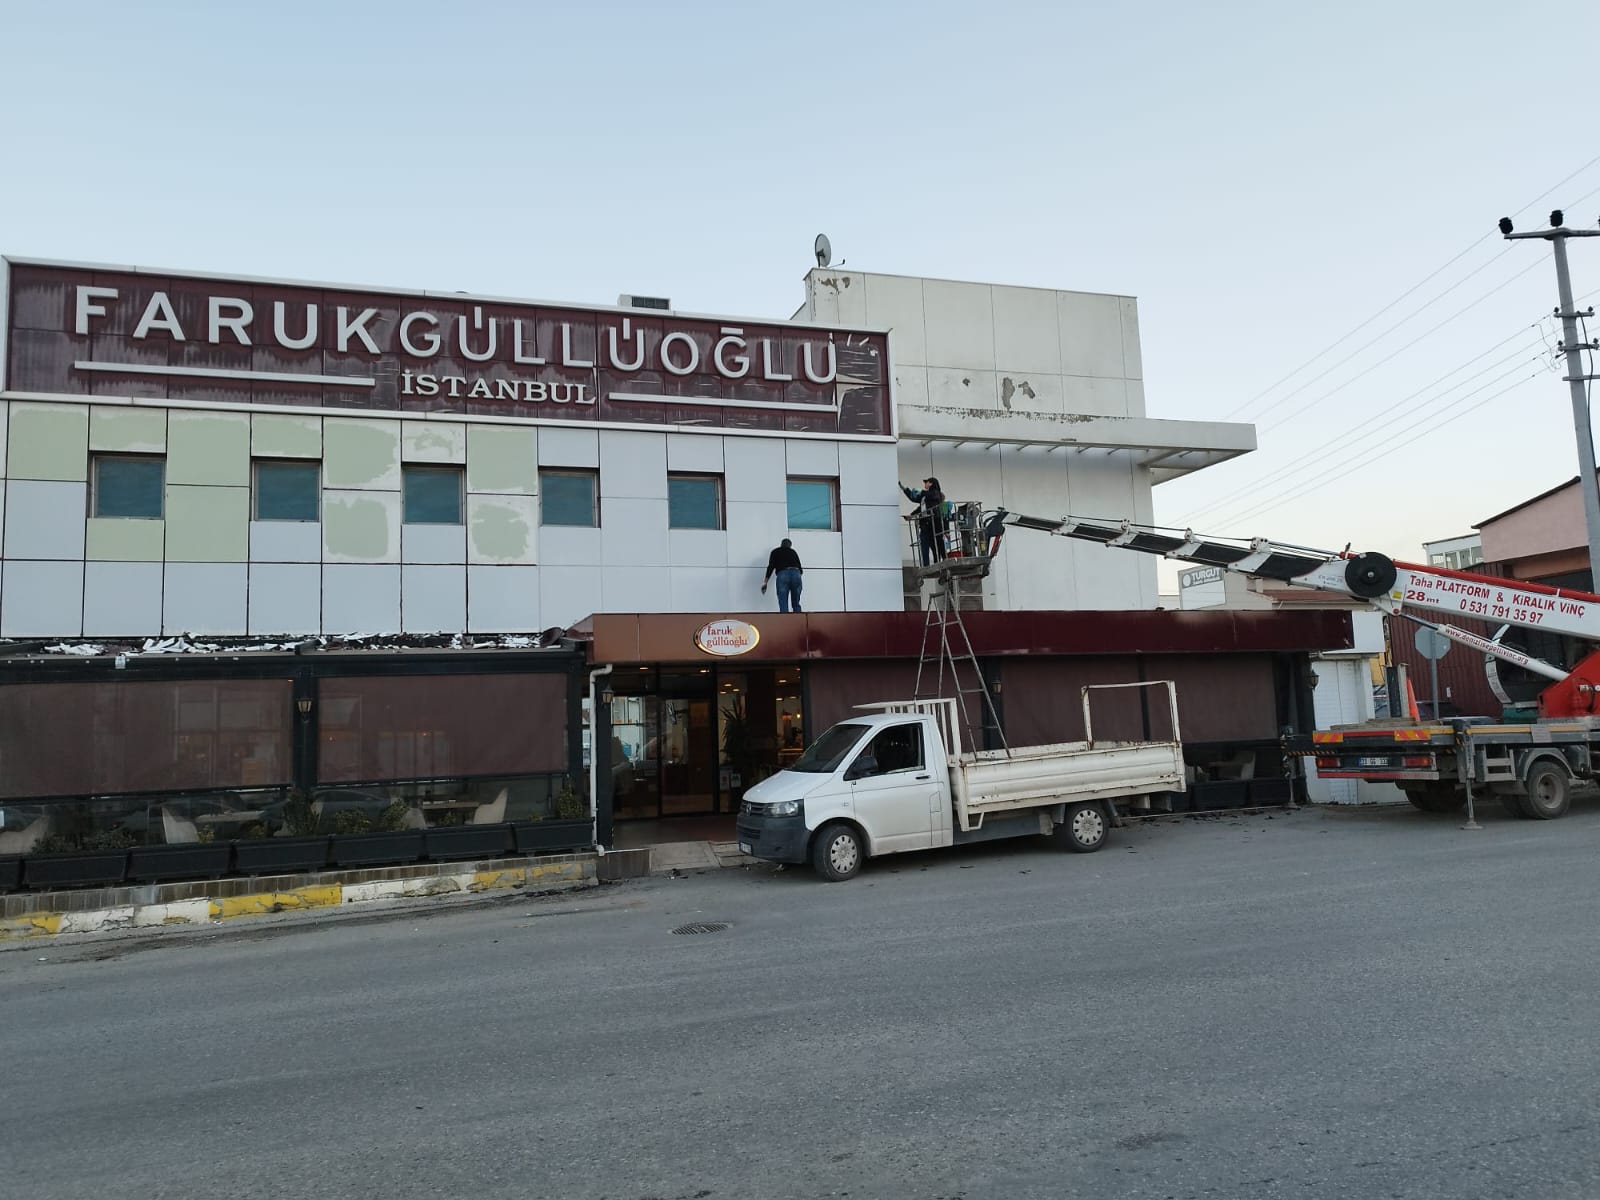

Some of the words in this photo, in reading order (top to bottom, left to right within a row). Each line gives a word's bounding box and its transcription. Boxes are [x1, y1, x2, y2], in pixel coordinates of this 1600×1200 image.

[401, 369, 597, 405] İSTANBUL
[1191, 567, 1220, 581] TURGUT
[1406, 589, 1426, 602] 28
[1410, 575, 1433, 589] Taha
[1435, 579, 1490, 600] PLATFORM
[1496, 591, 1504, 603] &
[1460, 598, 1467, 610] 0
[1469, 600, 1488, 615] 531
[1491, 604, 1510, 619] 791
[1513, 608, 1527, 622] 35
[1529, 611, 1544, 625] 97
[706, 625, 733, 636] faruk
